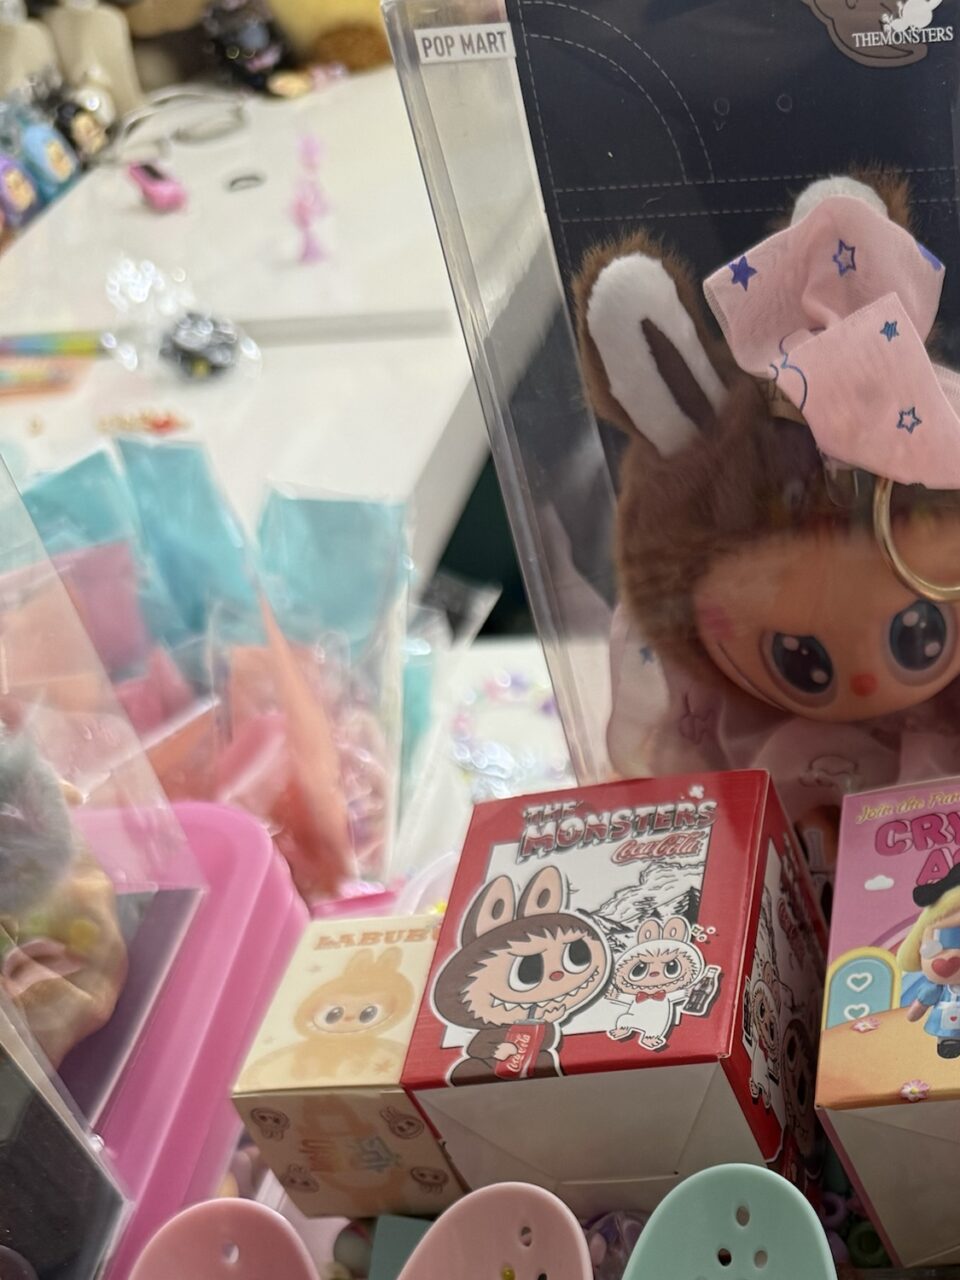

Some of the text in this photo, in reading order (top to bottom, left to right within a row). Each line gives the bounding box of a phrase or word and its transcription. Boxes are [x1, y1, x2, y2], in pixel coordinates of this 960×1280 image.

[421, 31, 507, 58] POP MART
[523, 799, 581, 823] THE
[516, 800, 718, 864] MONSTERS
[313, 924, 441, 951] LABUB
